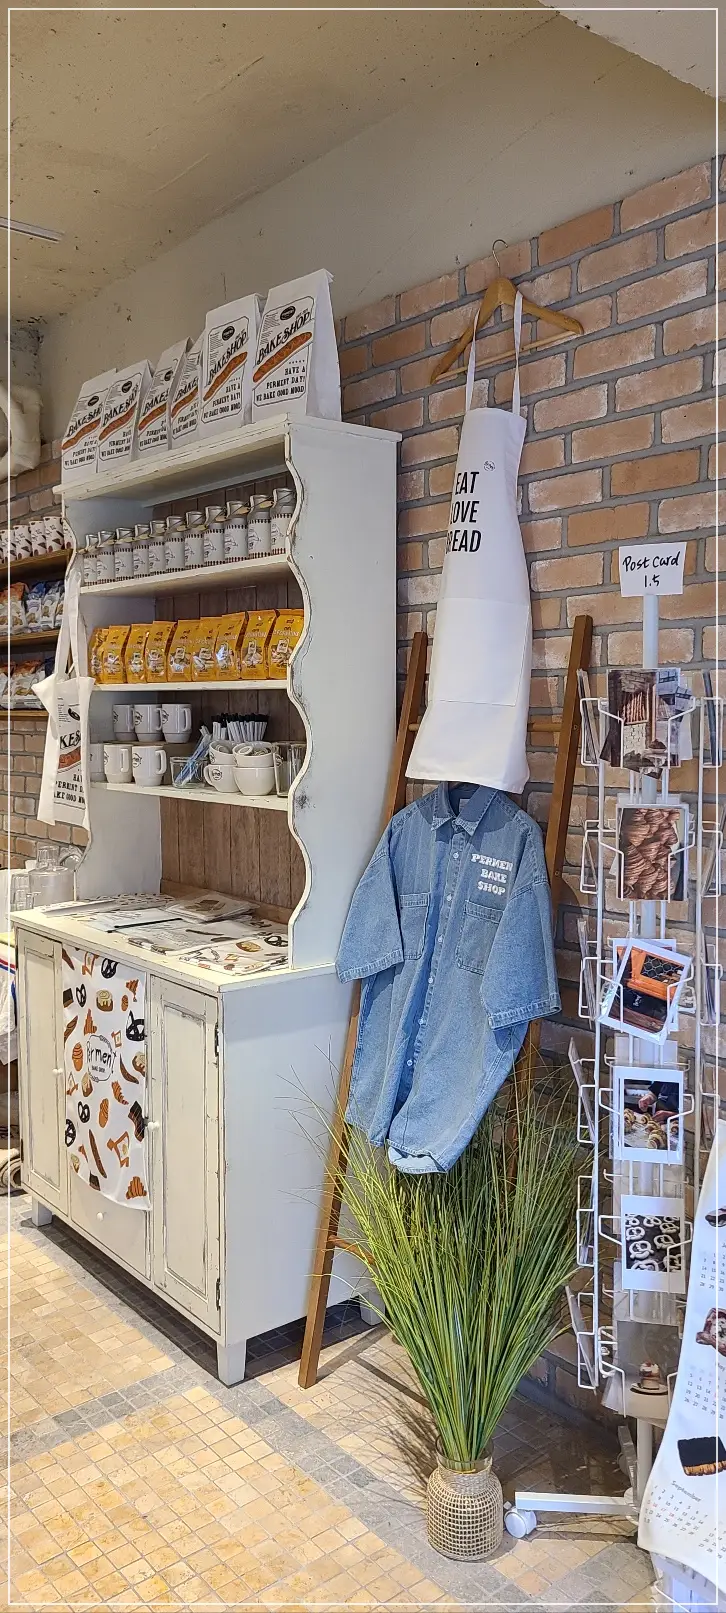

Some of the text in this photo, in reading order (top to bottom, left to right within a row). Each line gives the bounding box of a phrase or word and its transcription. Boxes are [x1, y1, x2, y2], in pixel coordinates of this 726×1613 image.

[455, 472, 480, 495] EAT
[622, 551, 681, 572] Post Card
[644, 574, 660, 588] 1.5
[480, 868, 508, 884] BAKE
[477, 880, 506, 896] SHOP
[671, 1480, 702, 1502] September
